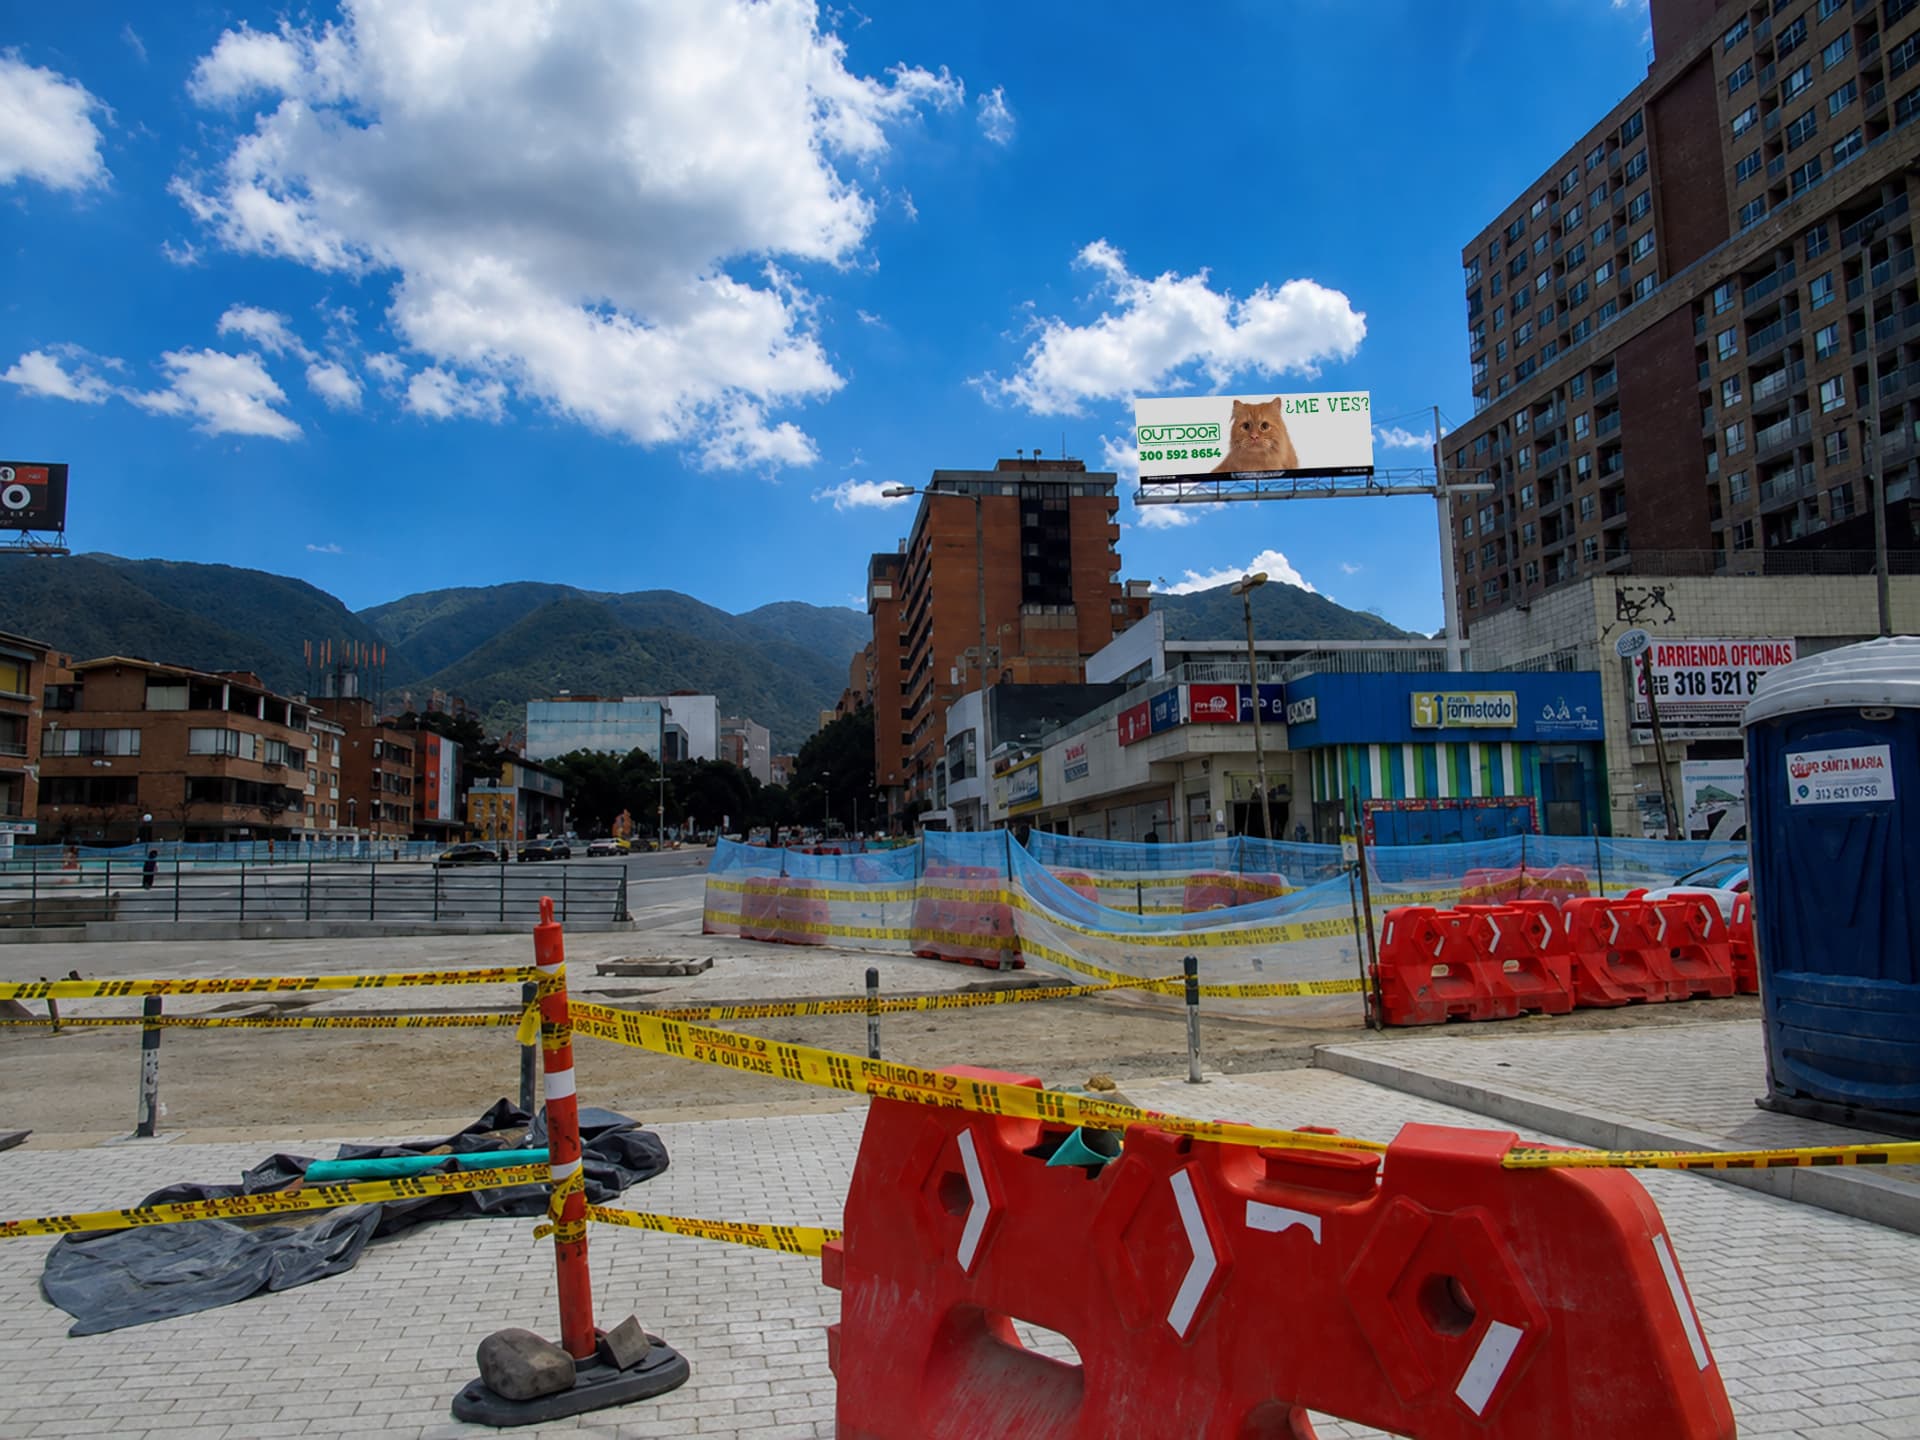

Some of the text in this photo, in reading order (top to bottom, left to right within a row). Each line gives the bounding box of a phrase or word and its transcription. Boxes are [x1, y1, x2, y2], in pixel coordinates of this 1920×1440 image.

[1328, 396, 1370, 413] VES?
[1140, 426, 1219, 441] OUTDOOR
[1139, 447, 1222, 462] 300 592 8654
[1657, 644, 1729, 667] ARRIENDA
[1731, 643, 1793, 666] OFICINAS
[1673, 671, 1706, 696] 318
[1711, 671, 1742, 696] 521
